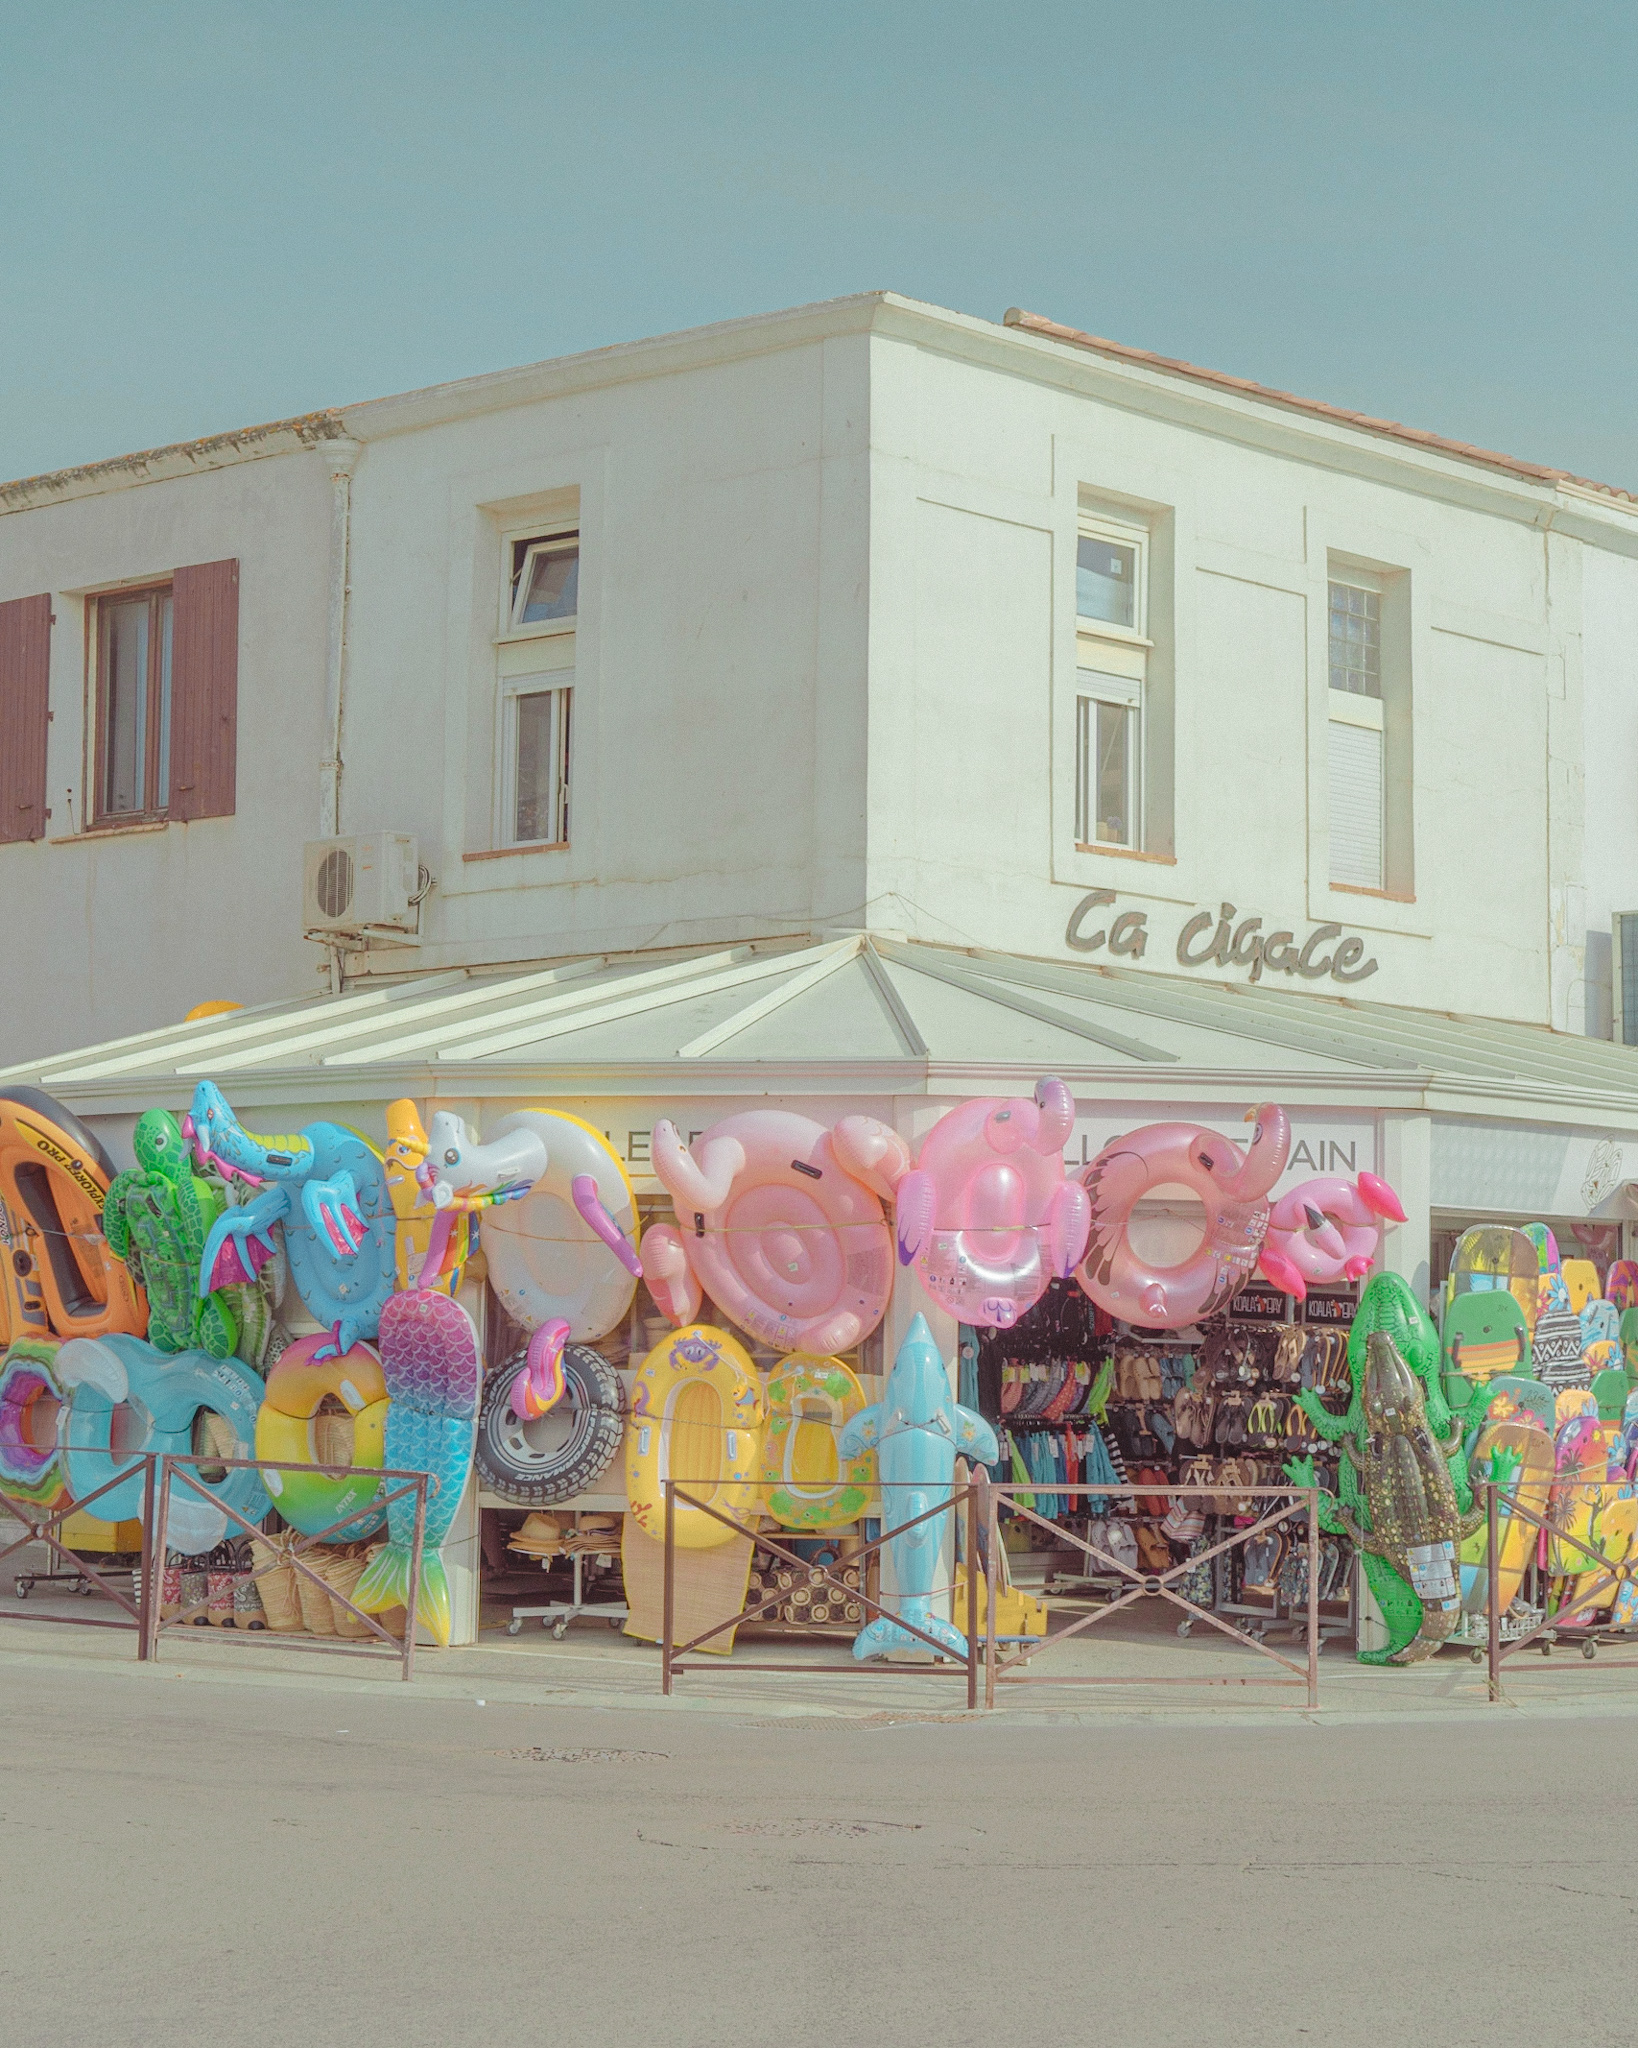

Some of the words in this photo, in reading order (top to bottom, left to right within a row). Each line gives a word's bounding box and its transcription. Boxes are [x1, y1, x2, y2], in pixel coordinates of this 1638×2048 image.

[37, 1140, 65, 1162] PRO
[1286, 1139, 1357, 1171] AIN
[1232, 1295, 1257, 1312] KOALA
[1308, 1299, 1333, 1318] KOALA
[515, 1417, 596, 1482] PERFORMANCE
